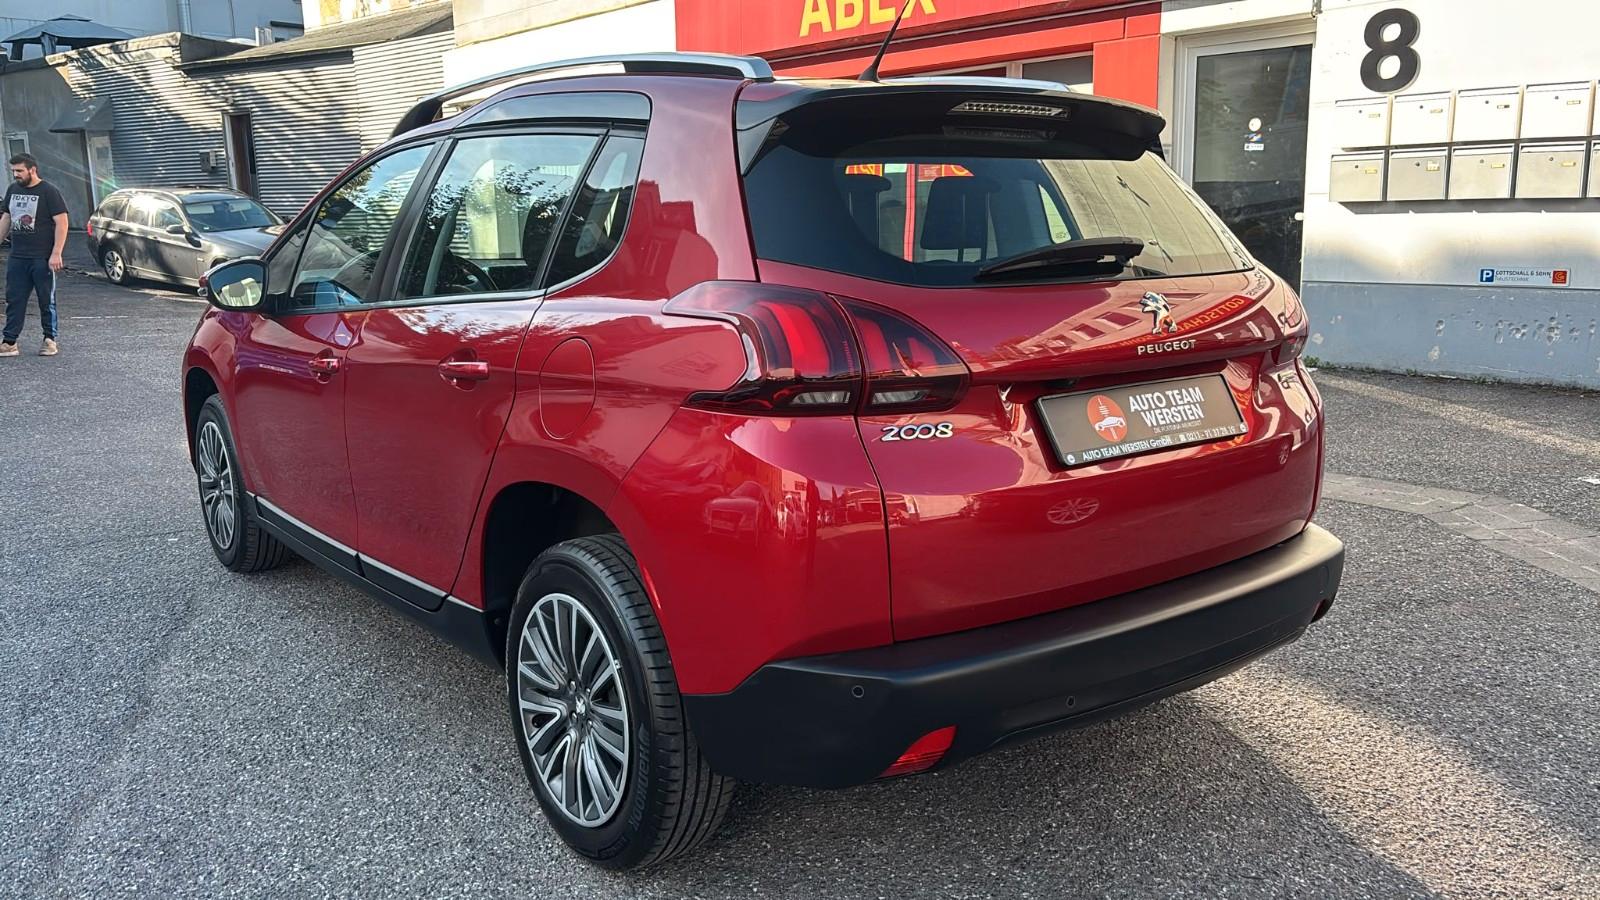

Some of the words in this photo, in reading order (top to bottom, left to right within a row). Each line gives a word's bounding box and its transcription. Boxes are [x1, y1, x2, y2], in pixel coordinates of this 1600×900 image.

[1360, 8, 1421, 94] 8
[1137, 339, 1197, 356] PEUGEOT
[1128, 391, 1167, 413] AUTO
[1165, 386, 1205, 406] TEAM
[1140, 403, 1205, 428] WERSTEN
[881, 422, 954, 442] 2008
[1082, 449, 1101, 461] AUTO
[1101, 445, 1121, 458] TEAM
[1120, 439, 1150, 454] WERSTEN
[1149, 434, 1172, 448] GmbH
